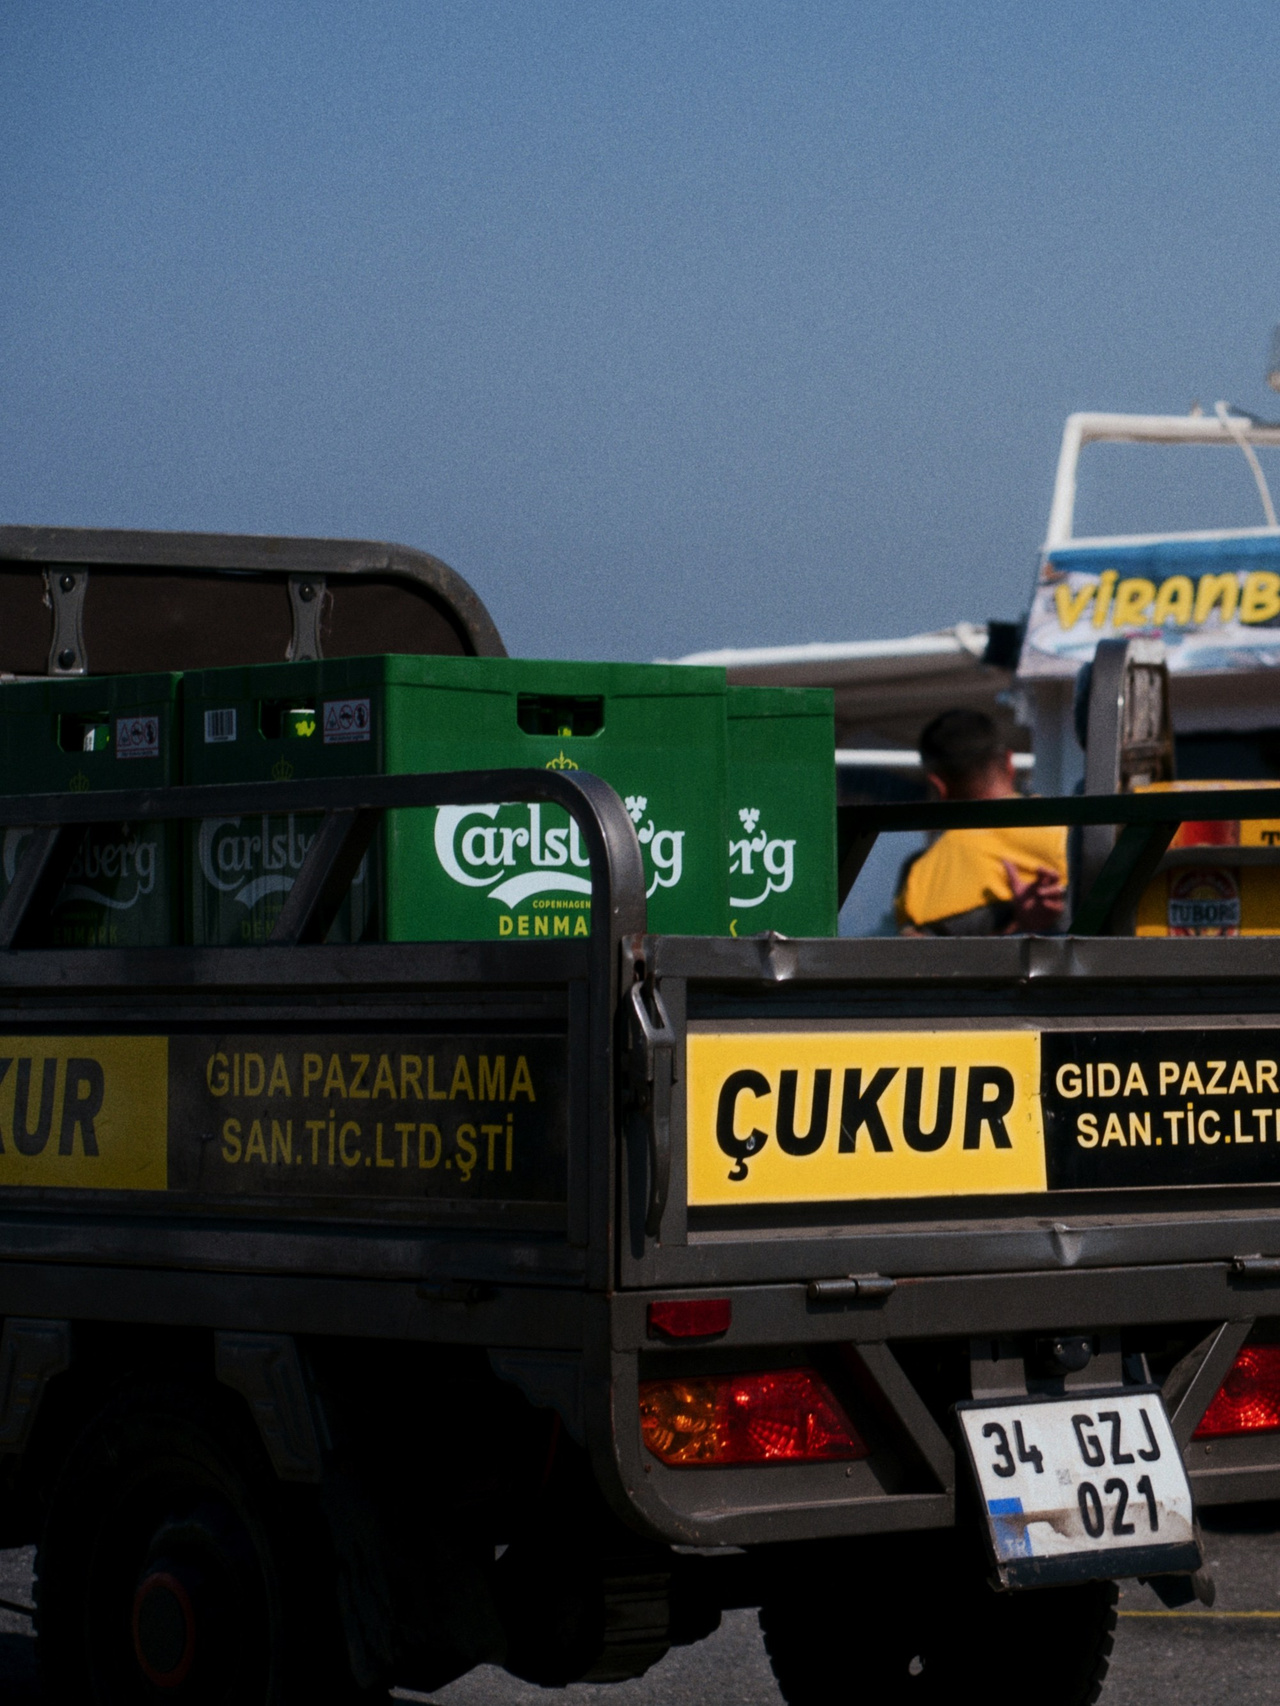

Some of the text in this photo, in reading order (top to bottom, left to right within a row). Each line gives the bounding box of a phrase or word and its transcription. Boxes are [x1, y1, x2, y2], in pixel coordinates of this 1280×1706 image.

[499, 915, 588, 936] DENMA
[532, 900, 592, 909] COPENHAGEN
[207, 1052, 536, 1102] GIDA PAZARLAMA
[1055, 1062, 1149, 1098] GIDA
[222, 1109, 514, 1181] SAN.TİC.LTD.ŞTİ
[715, 1064, 1016, 1181] ÇUKUR
[982, 1408, 1161, 1477] 34 GZJ
[1077, 1475, 1160, 1538] 021
